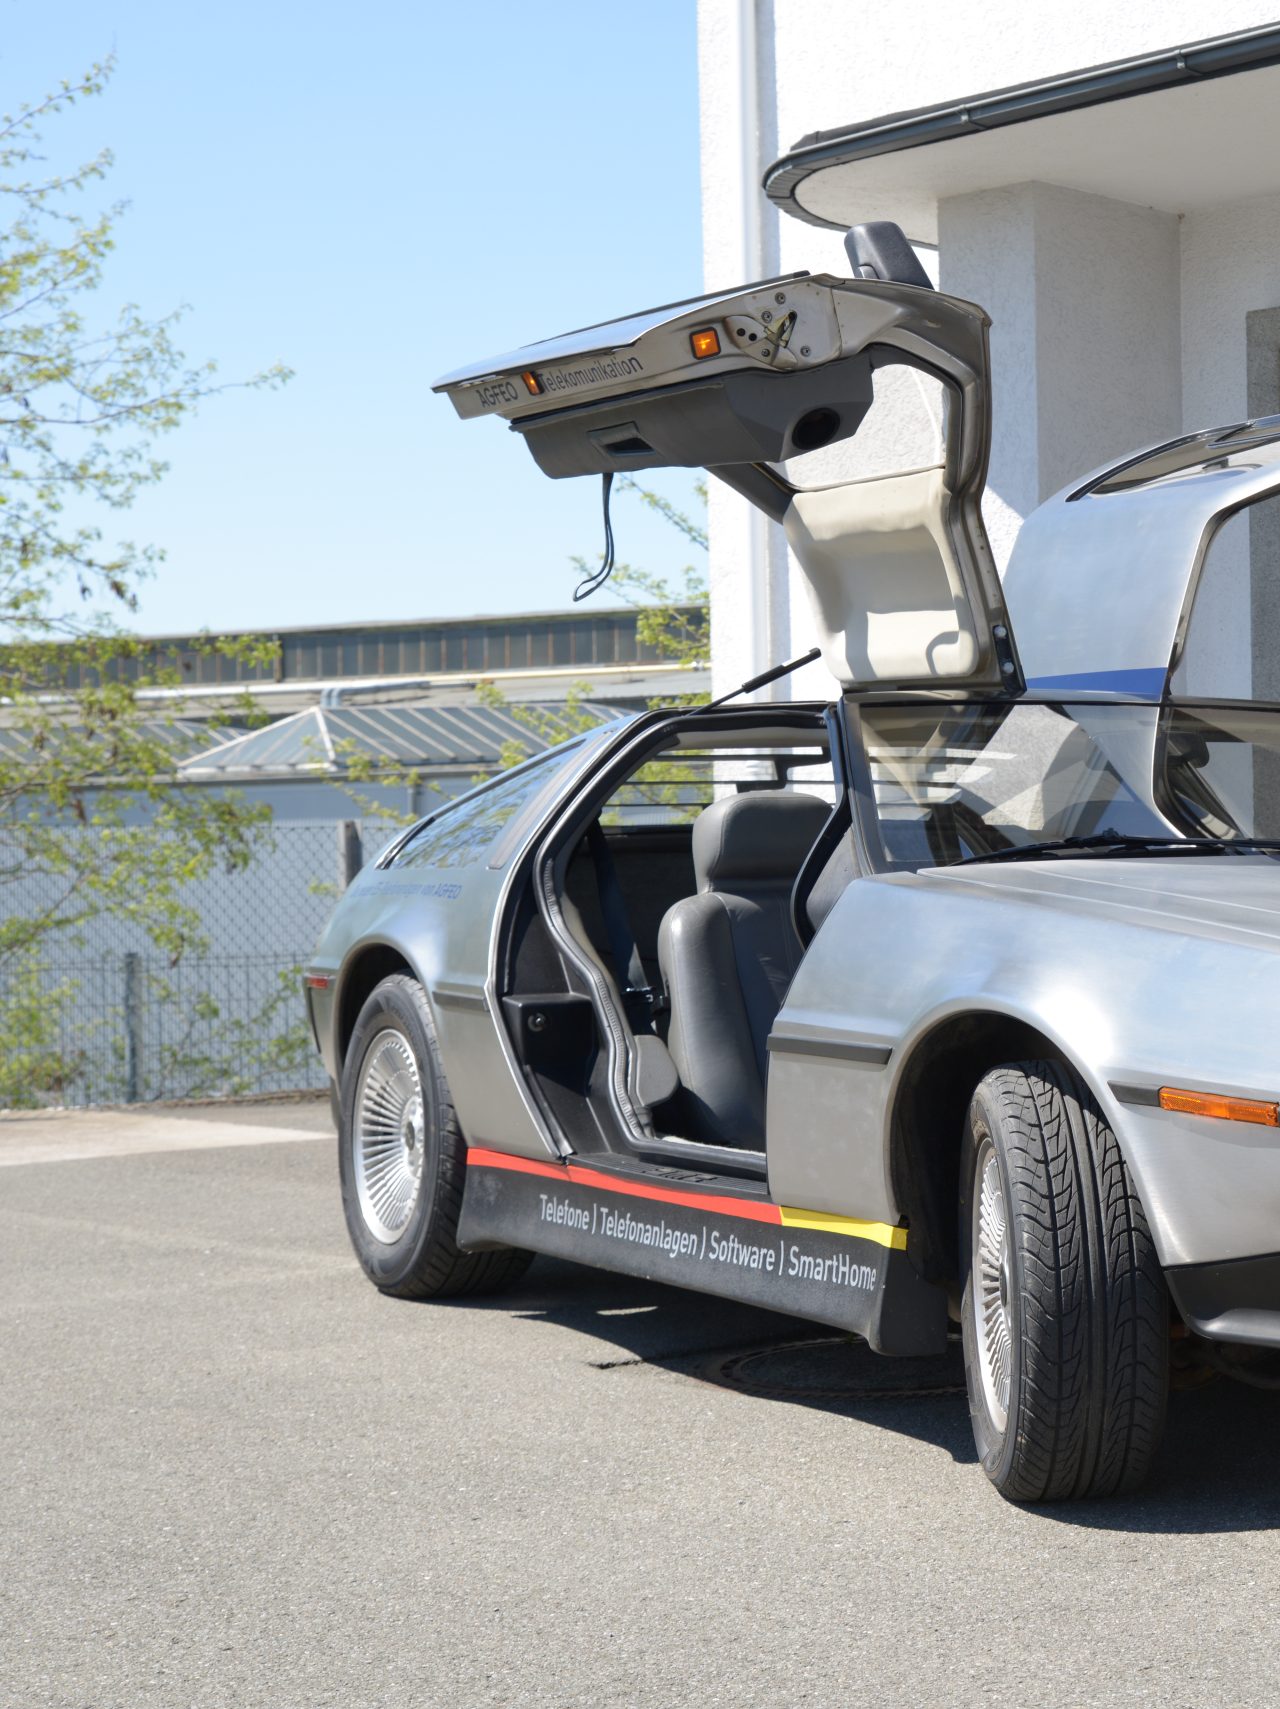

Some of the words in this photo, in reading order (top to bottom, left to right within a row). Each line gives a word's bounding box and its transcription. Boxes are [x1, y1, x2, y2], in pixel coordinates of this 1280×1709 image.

[475, 381, 519, 407] AGFEO
[539, 1194, 590, 1230] Telefone
[600, 1207, 698, 1258] Telefonanlagen
[708, 1230, 776, 1271] Software
[788, 1245, 877, 1292] SmartHome
